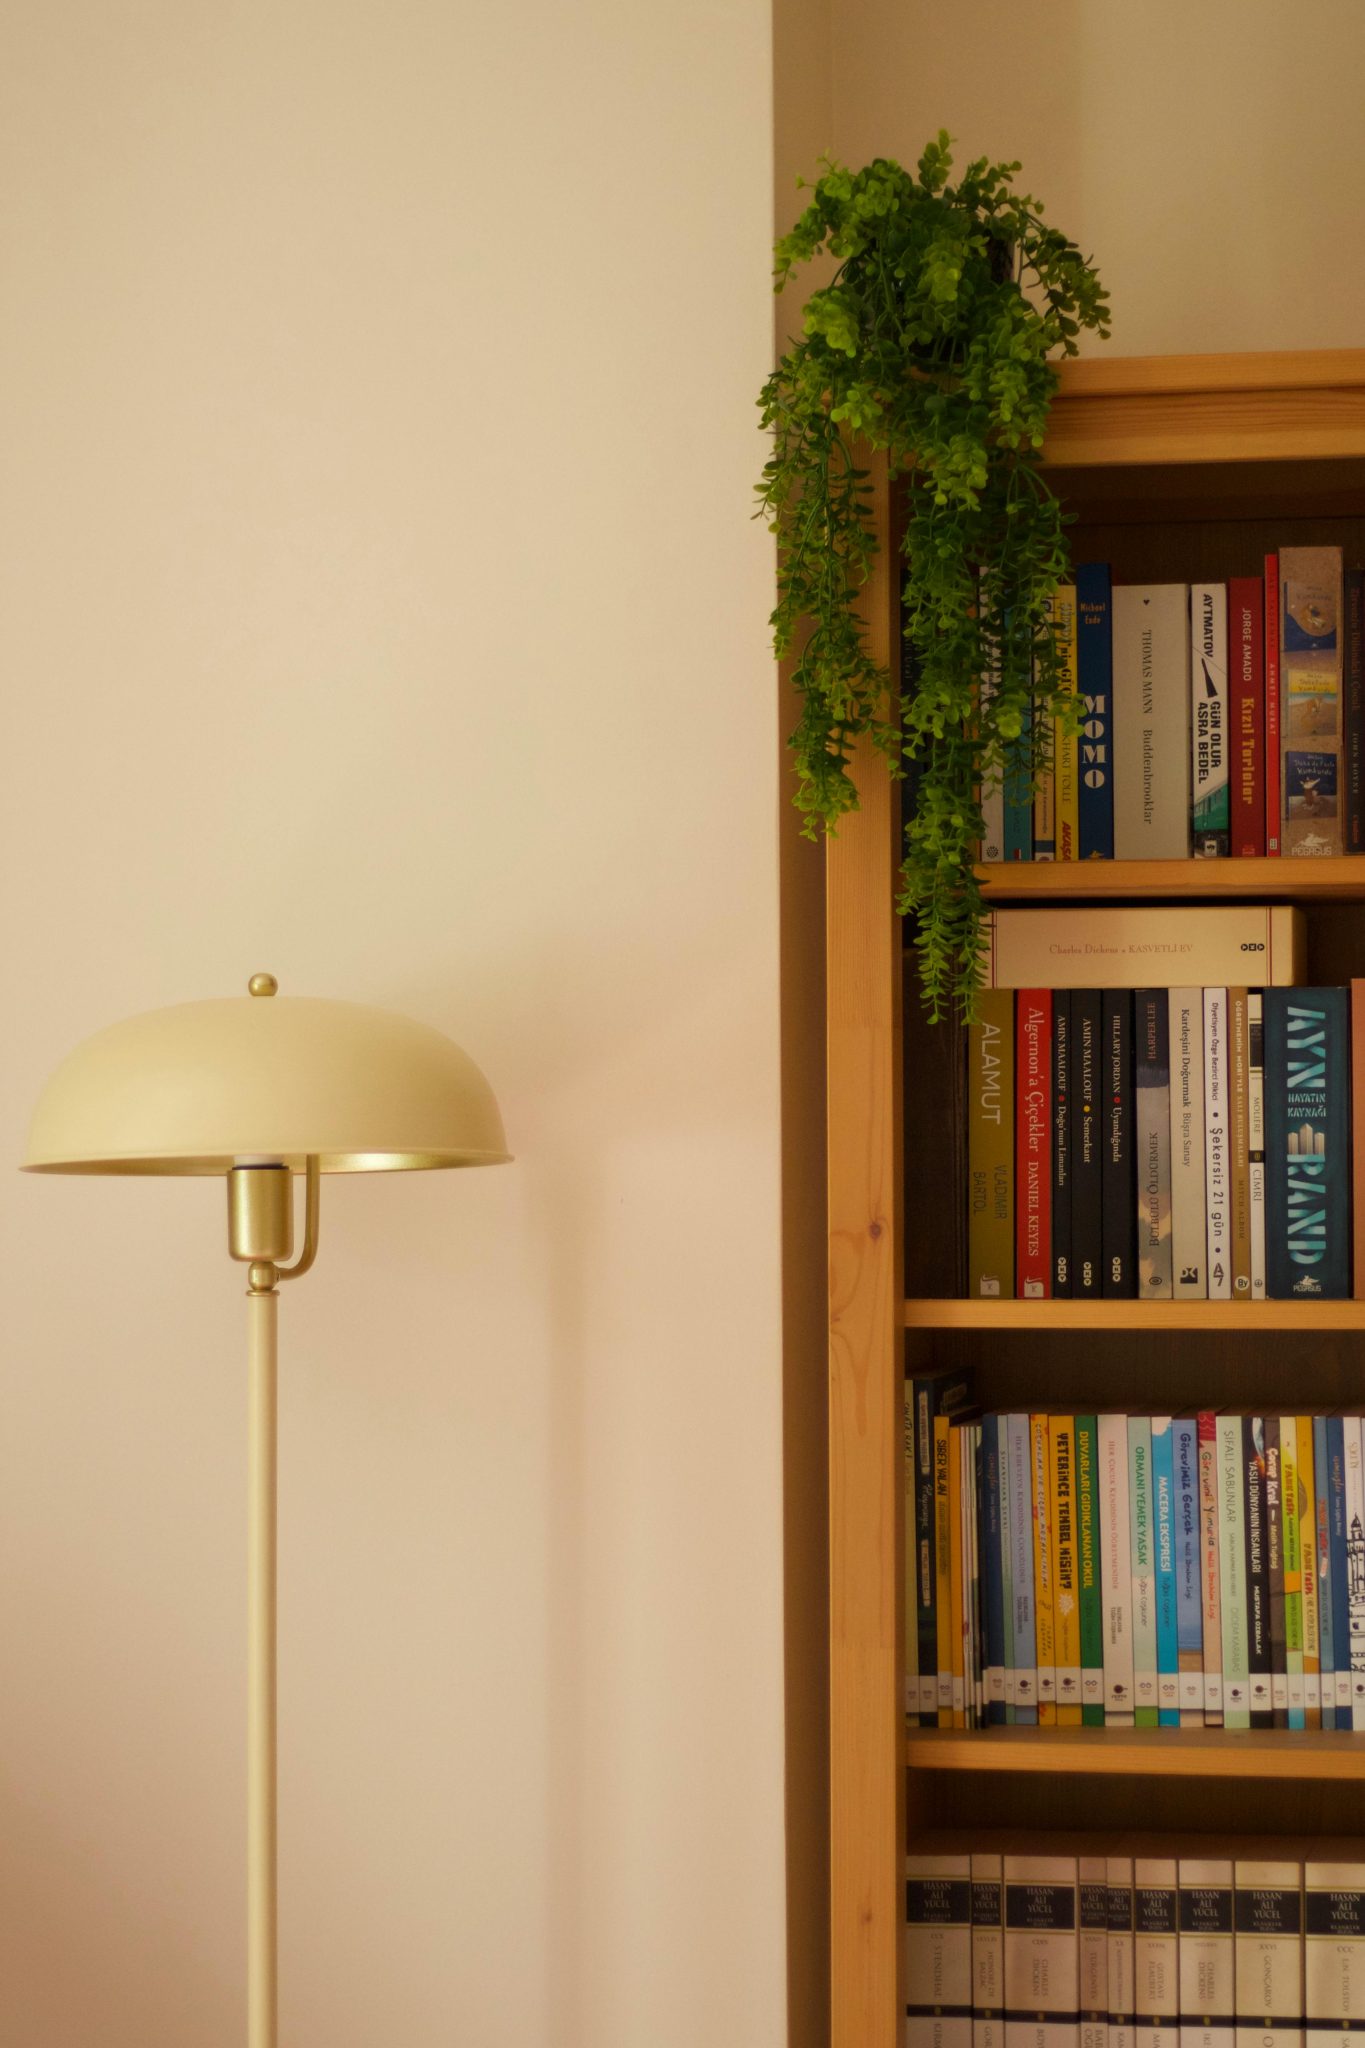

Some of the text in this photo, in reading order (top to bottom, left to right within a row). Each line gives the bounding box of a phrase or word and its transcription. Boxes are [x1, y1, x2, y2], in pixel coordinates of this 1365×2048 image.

[1203, 594, 1214, 658] AYTMATOV
[1241, 608, 1253, 681] JORGE AMADO
[1142, 629, 1153, 714] THOMAS MANN
[1268, 663, 1276, 697] AHMET
[1198, 702, 1209, 784] ASRA BEDEL
[1210, 733, 1222, 768] OLUR
[1241, 698, 1255, 804] Kızıl Tarlalar
[1142, 729, 1153, 824] Buddenbrooklar
[982, 1022, 1000, 1125] ALAMUT
[1025, 1007, 1045, 1086] Algernon'a
[1287, 1006, 1326, 1088] AYN
[1056, 1015, 1066, 1186] AMIN MAALOUF Doğu'nun Limanları
[1083, 1018, 1093, 1163] AMIN MAALOUF Semerkant
[1112, 1015, 1122, 1162] HILLARY JORDAN Uyandığında
[1179, 1009, 1192, 1167] Kardeşini Doğurmak Büşra Sanay
[1288, 1093, 1326, 1103] HAYATIN
[1288, 1108, 1326, 1117] KAYNAĞI
[1025, 1091, 1044, 1152] Çiçekler
[1210, 1002, 1223, 1237] Diyetisyen Özge Bezirci Dikici Şekersiz 21 gün
[973, 1171, 987, 1215] BARTOL
[1028, 1161, 1039, 1211] DANIEL
[1287, 1154, 1326, 1264] RAND
[1028, 1215, 1039, 1256] KEYES
[1079, 1432, 1090, 1491] DUVARLARI
[1180, 1433, 1193, 1536] Görevimiz Gerçek
[1058, 1502, 1070, 1544] TEMBEL
[1136, 1446, 1147, 1565] ORMANI YEMEK YASAK
[1159, 1476, 1172, 1572] MACERA EKSPRESİ
[1225, 1467, 1236, 1522] SABUNLAR
[1249, 1486, 1260, 1527] DÜNYANIN
[1267, 1481, 1279, 1505] Kral
[1081, 1493, 1091, 1558] GIDIKLANAN
[1251, 1529, 1261, 1573] İNSANLARI
[1083, 1560, 1093, 1588] OKUL
[1026, 1888, 1055, 1896] HASAN
[1253, 1892, 1282, 1900] HASAN
[1330, 1894, 1360, 1902] HASAN
[1332, 1911, 1359, 1920] YÜCEL
